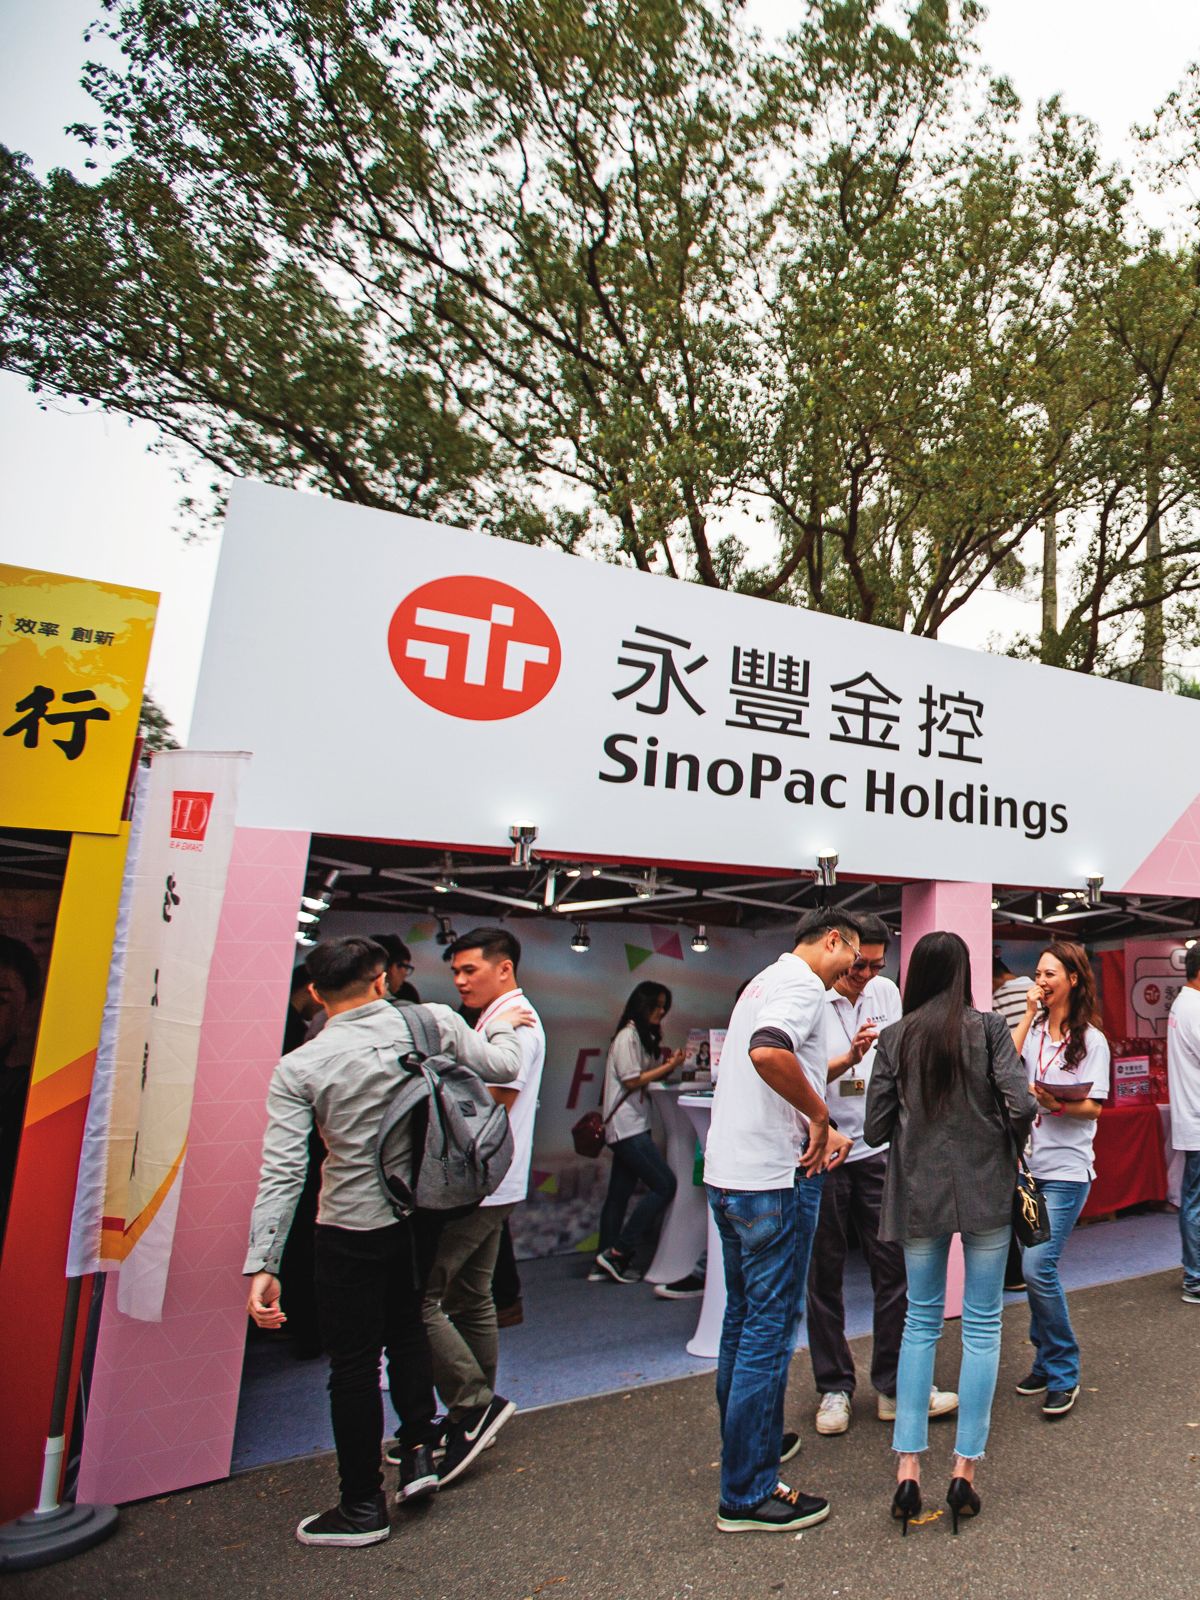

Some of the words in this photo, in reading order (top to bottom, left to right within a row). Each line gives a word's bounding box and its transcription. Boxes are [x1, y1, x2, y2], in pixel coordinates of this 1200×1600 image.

[14, 618, 60, 637] 效率
[70, 626, 115, 646] 創新
[3, 685, 110, 760] 行
[611, 625, 984, 764] 永豐金控
[598, 732, 848, 809] SinoPac
[865, 768, 1069, 840] Holdings
